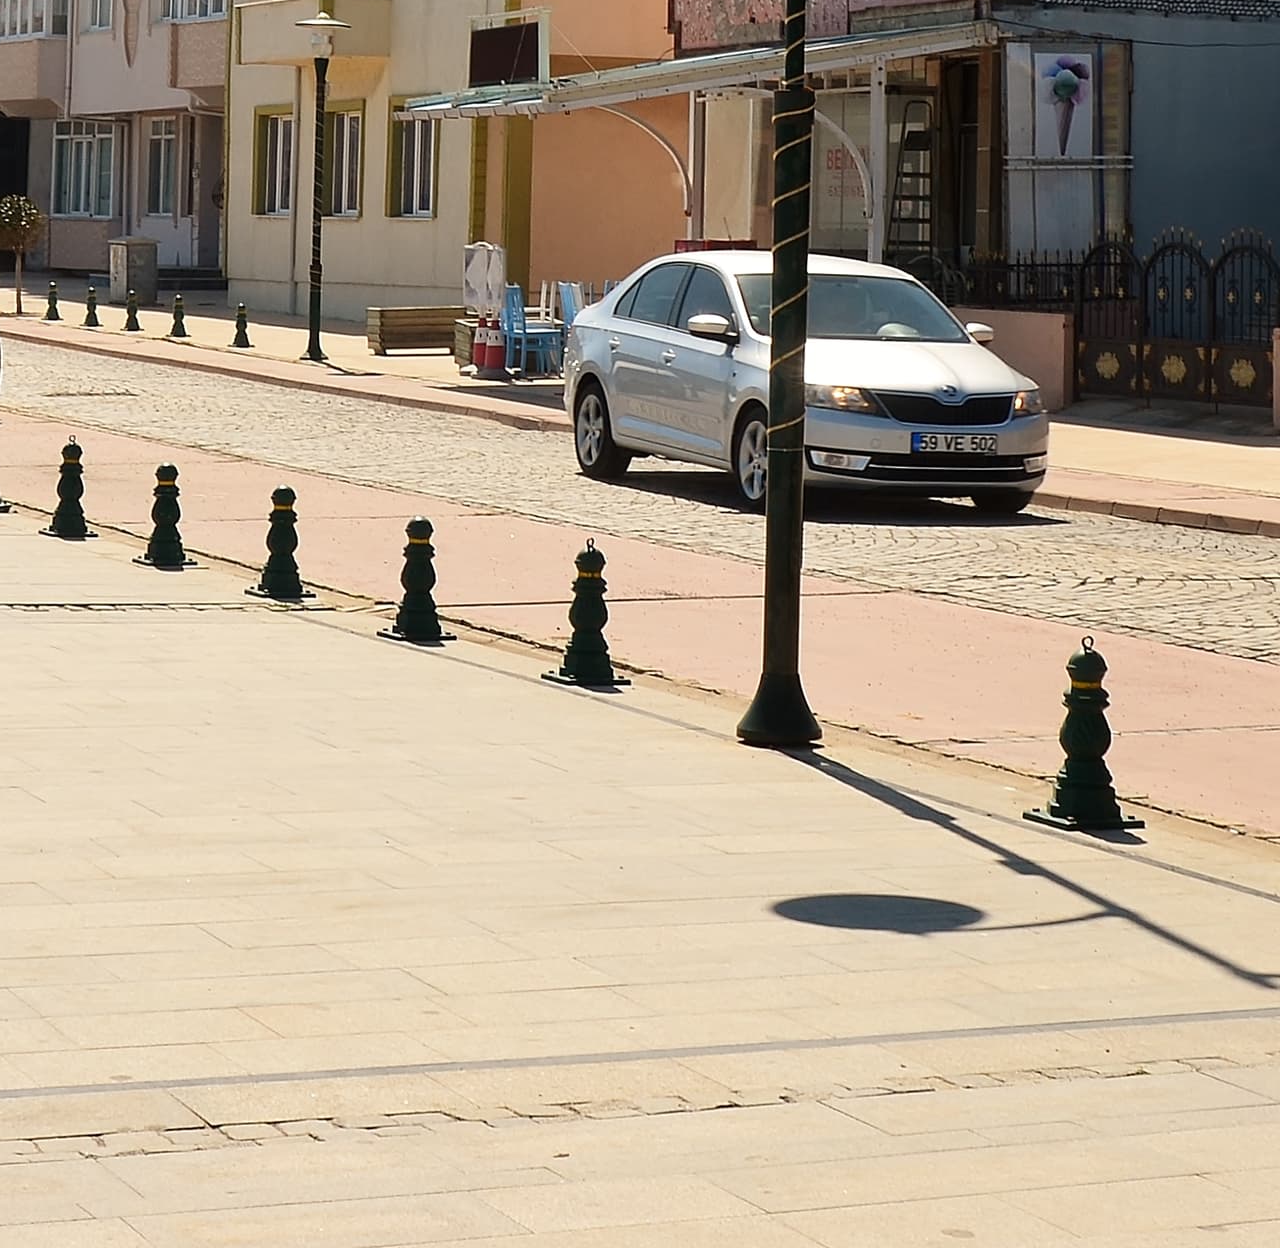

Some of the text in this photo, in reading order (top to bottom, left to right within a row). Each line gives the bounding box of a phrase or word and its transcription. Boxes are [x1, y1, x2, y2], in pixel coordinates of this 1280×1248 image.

[920, 435, 996, 452] 59 VE 502
